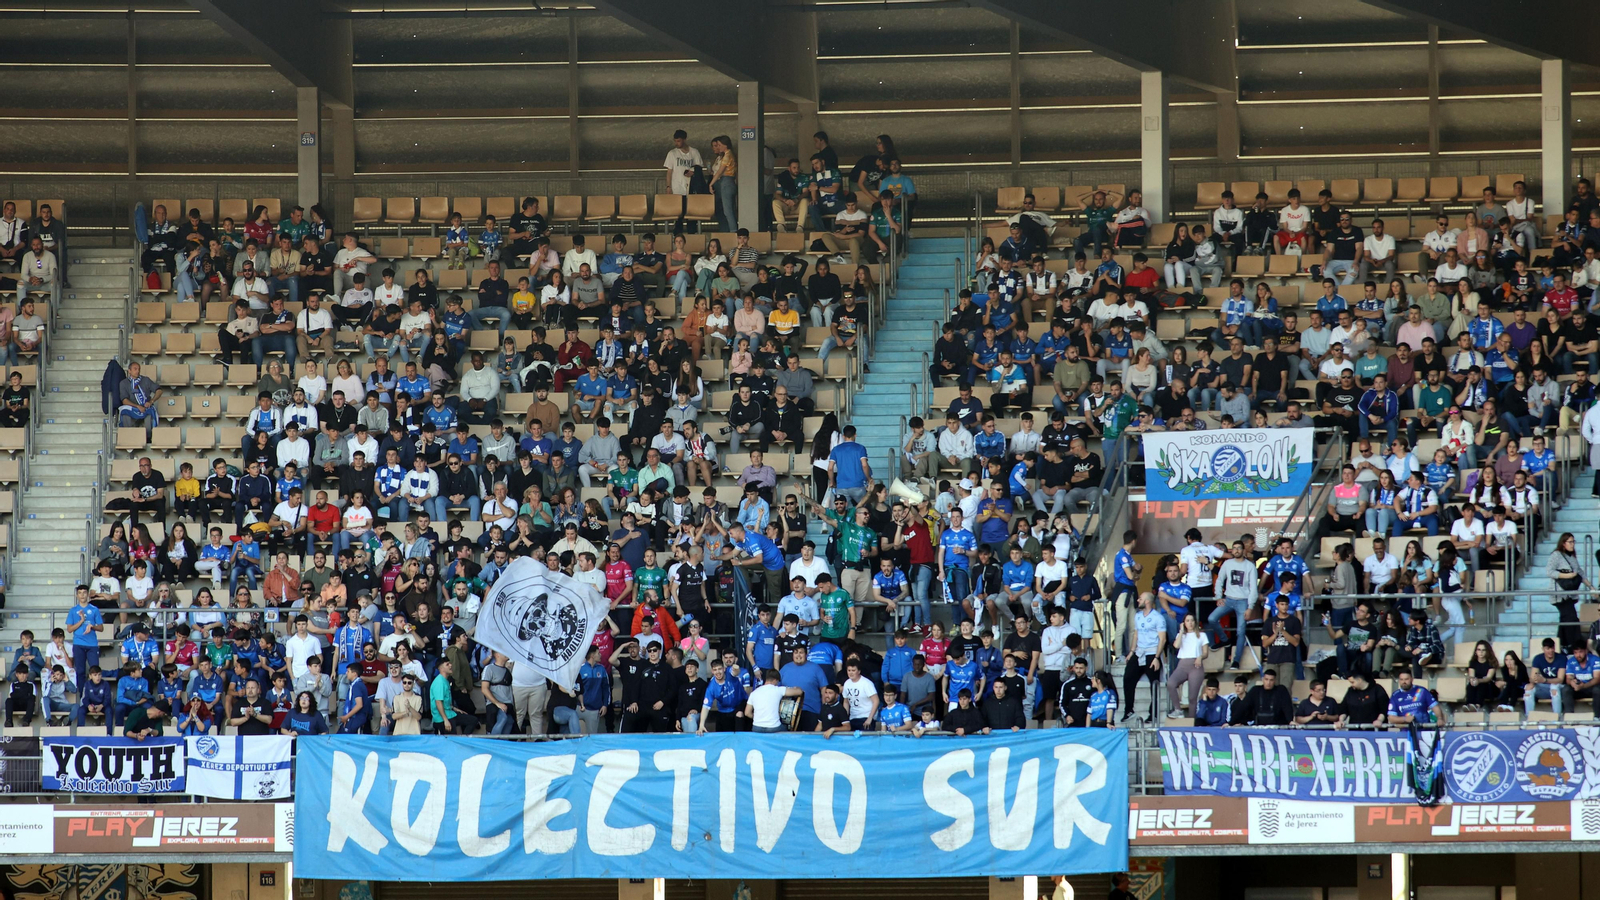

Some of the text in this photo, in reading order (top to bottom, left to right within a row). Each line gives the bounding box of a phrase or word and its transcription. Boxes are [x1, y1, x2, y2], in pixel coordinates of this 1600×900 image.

[302, 137, 314, 145] 319
[742, 131, 755, 139] 319
[1190, 432, 1267, 446] KOMANDO
[1138, 498, 1296, 527] PLAY JEREZ
[560, 617, 586, 662] HOOLIGANS
[1516, 732, 1582, 762] KOLECTIVO SUR
[50, 744, 176, 782] YOUTH
[201, 761, 223, 770] XEREZ
[1159, 730, 1416, 798] WE ARE XEREZ
[1466, 748, 1493, 787] XEREZ
[59, 774, 172, 793] Kolectivo Sur
[1457, 782, 1509, 801] DEPORTIVO
[923, 744, 1112, 852] SUR
[1285, 812, 1343, 820] Ayuntamiento
[1297, 820, 1318, 829] Jerez
[1368, 805, 1536, 836] PLAY JEREZ
[67, 811, 239, 847] PLAY JEREZ
[261, 877, 273, 885] 118
